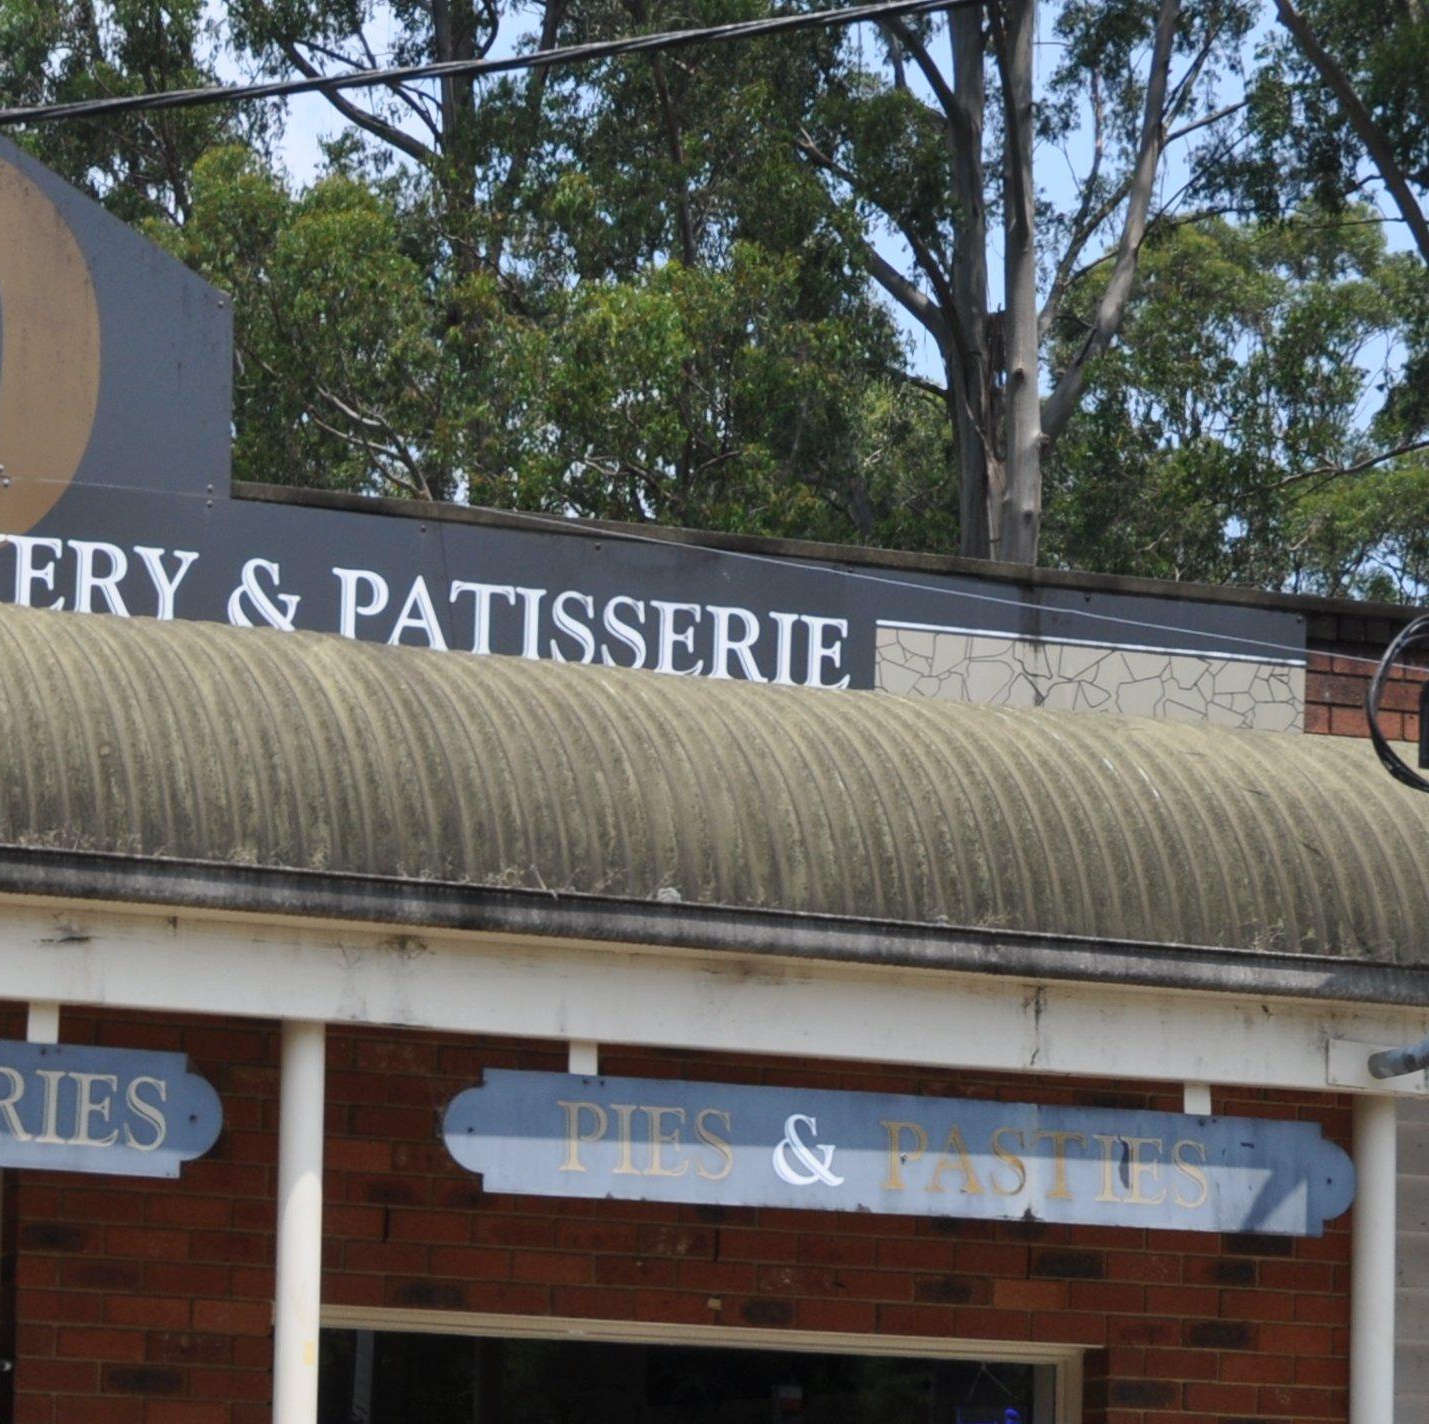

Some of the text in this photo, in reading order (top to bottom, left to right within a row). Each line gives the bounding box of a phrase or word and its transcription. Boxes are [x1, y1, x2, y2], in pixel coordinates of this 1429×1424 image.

[227, 556, 302, 632] &
[331, 565, 852, 692] PATISSERIE
[557, 1099, 1210, 1210] PIES & PASTIES
